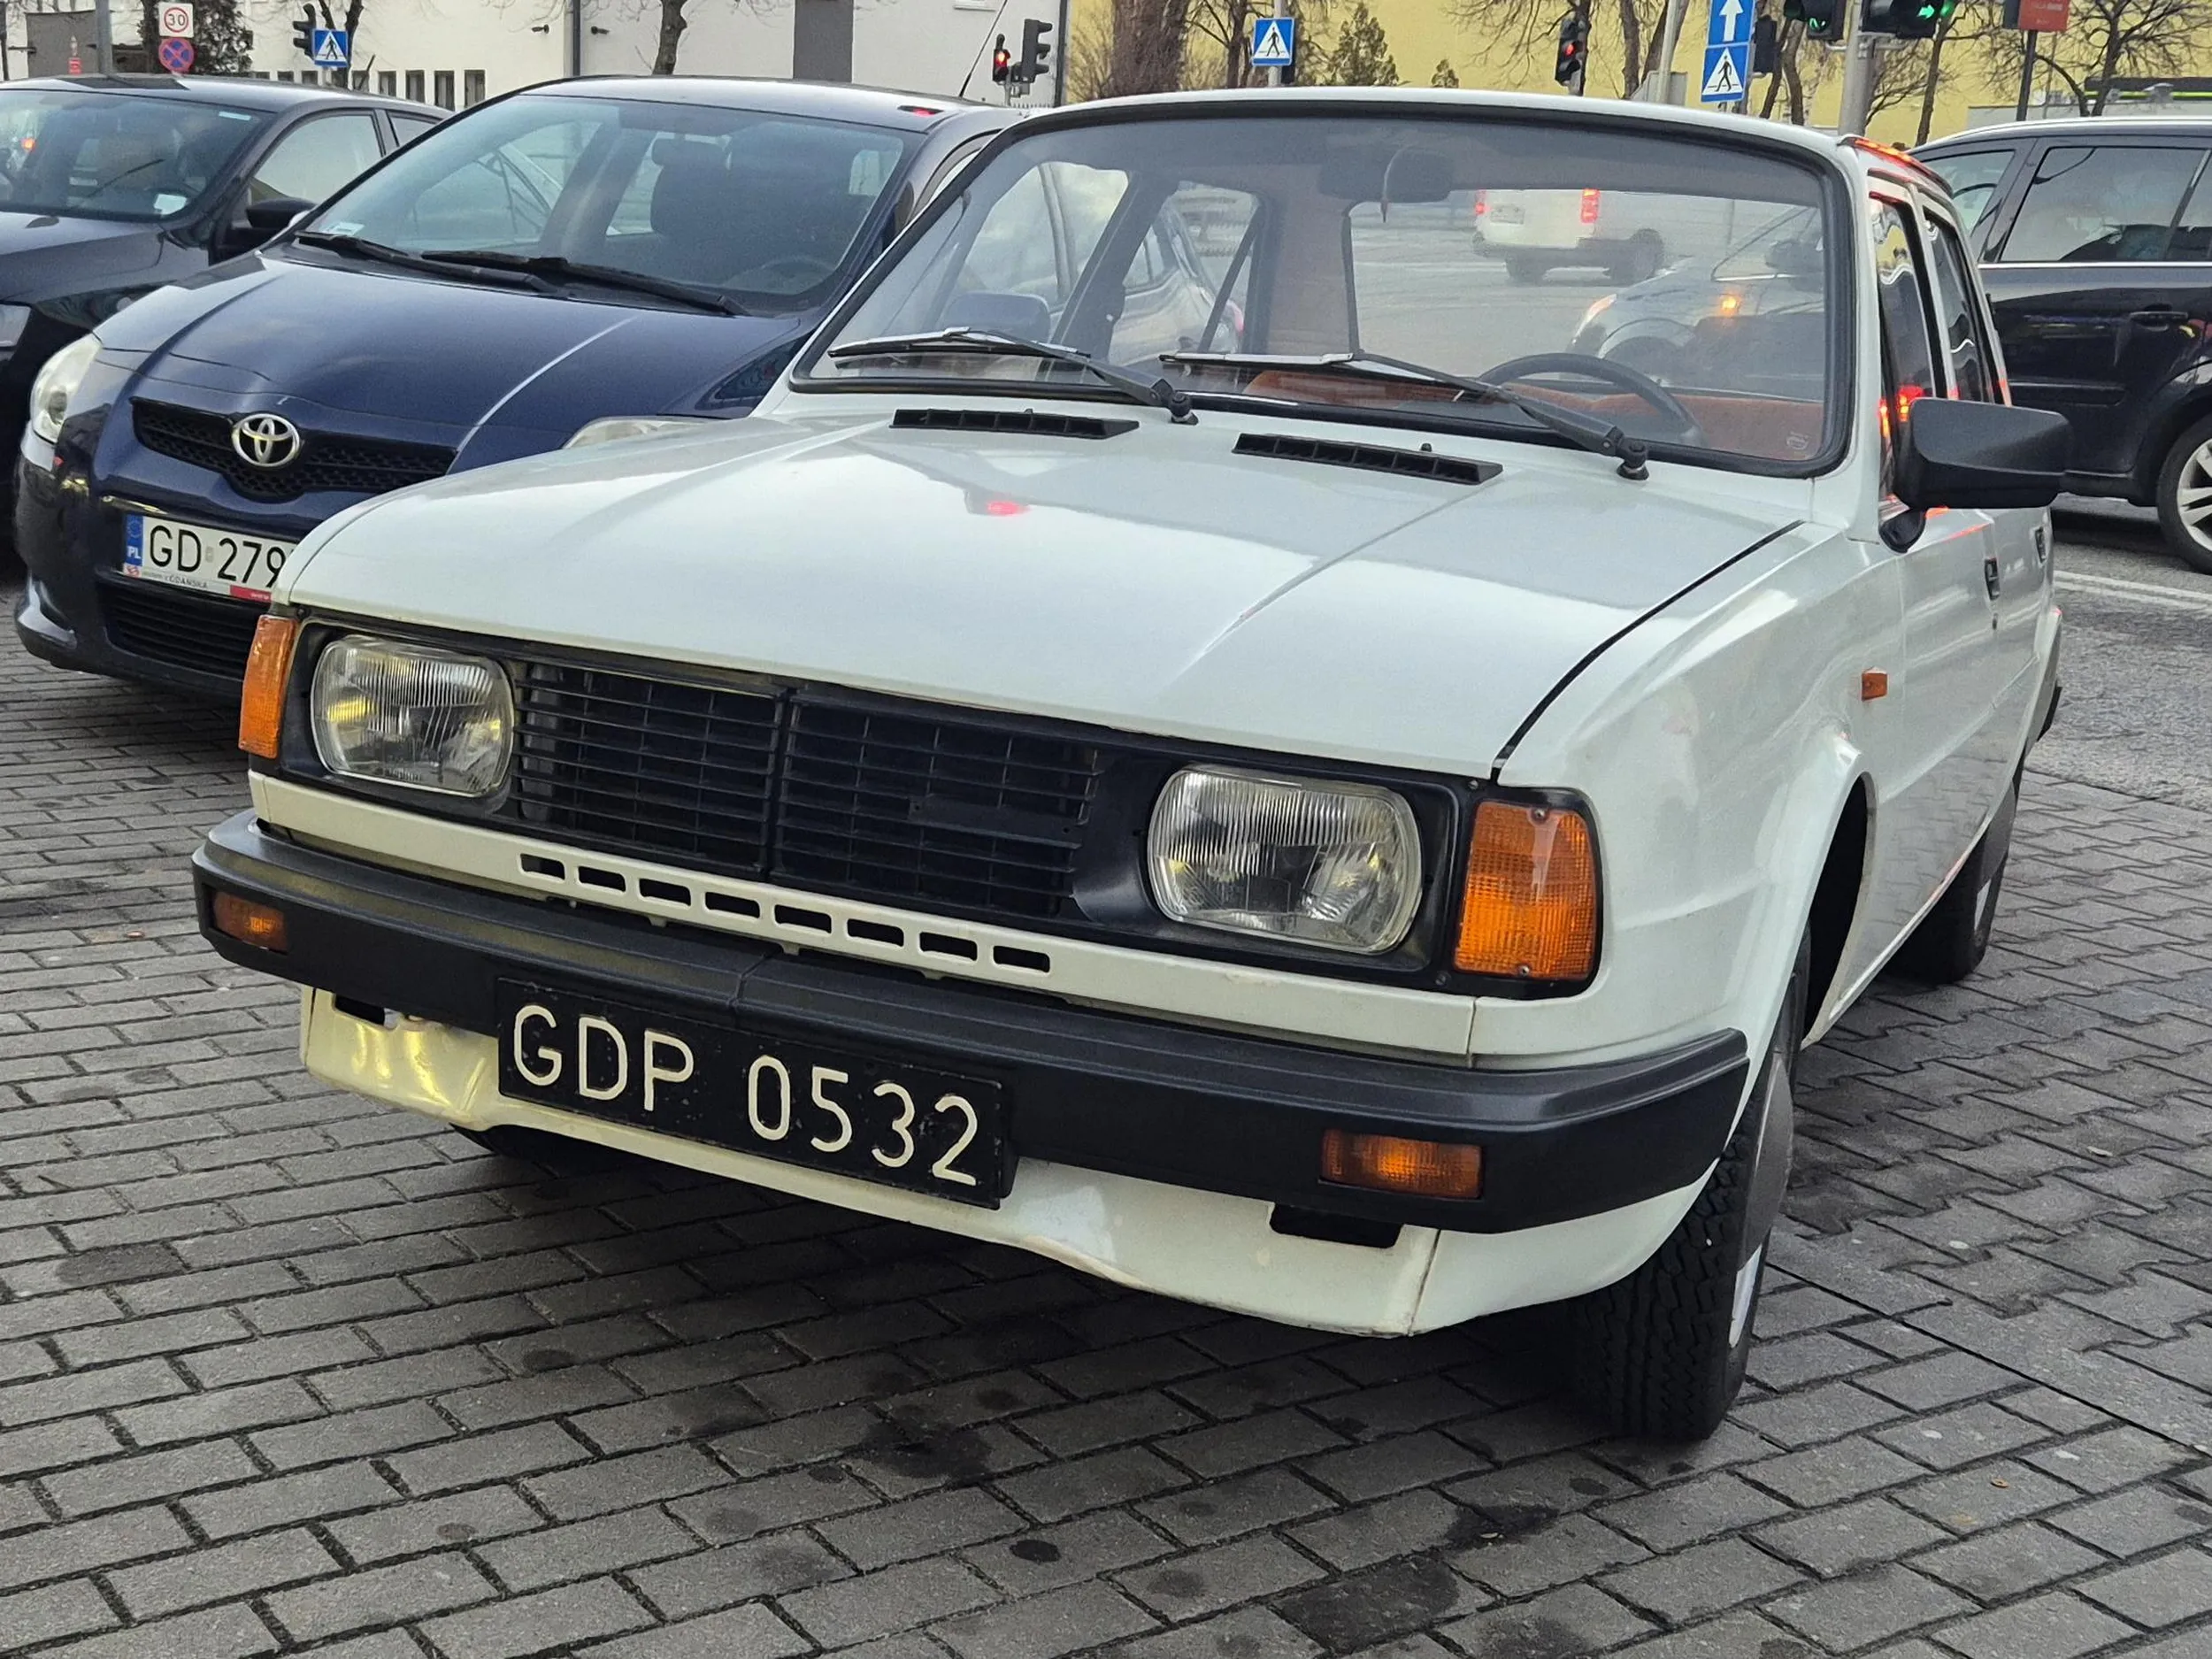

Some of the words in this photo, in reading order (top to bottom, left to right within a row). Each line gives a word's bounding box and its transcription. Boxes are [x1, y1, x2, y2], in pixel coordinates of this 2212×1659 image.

[168, 13, 186, 27] 30
[127, 545, 142, 559] PL
[150, 525, 202, 572] GD
[217, 537, 295, 588] 279
[513, 1004, 695, 1112] GDP
[747, 1054, 979, 1187] 0532
